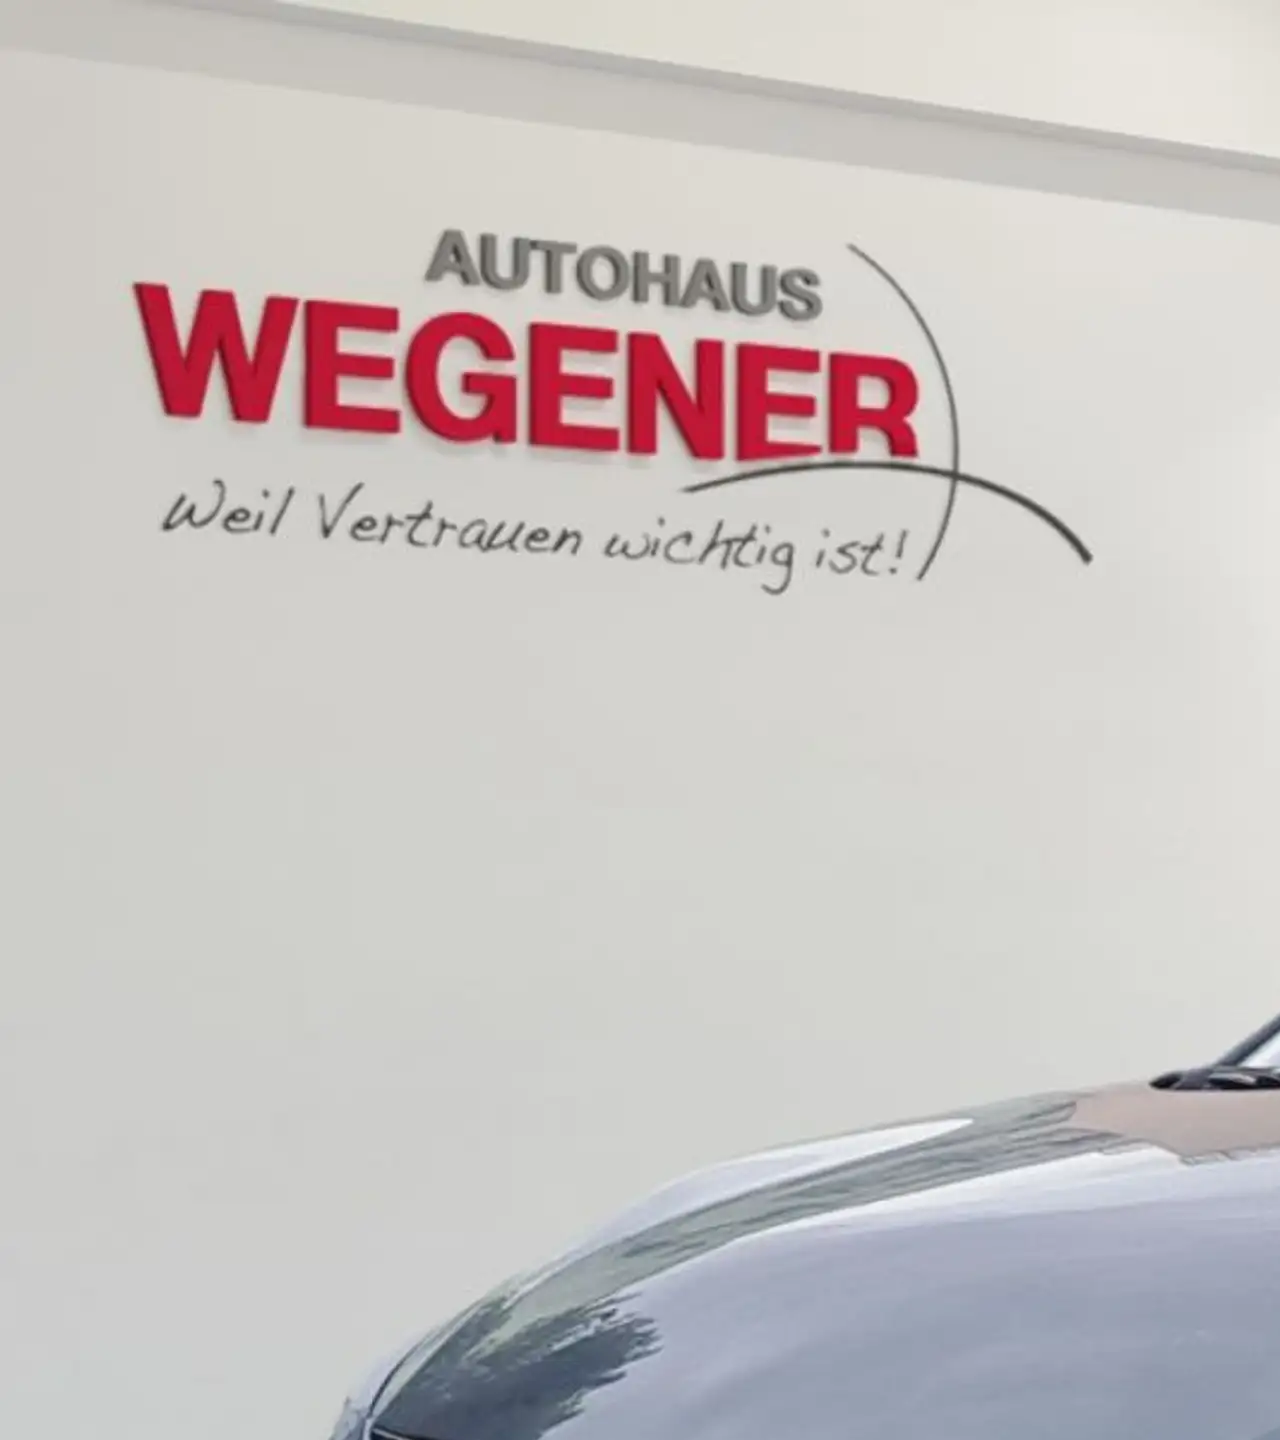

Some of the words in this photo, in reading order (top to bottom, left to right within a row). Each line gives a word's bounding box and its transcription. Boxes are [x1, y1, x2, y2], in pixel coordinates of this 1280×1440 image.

[425, 229, 821, 321] AUTOHAUS
[132, 281, 920, 462] WEGENER
[162, 480, 290, 537] Weil
[317, 483, 583, 557] Vertrauen
[605, 515, 794, 595] wichtig
[815, 529, 906, 577] ist!
